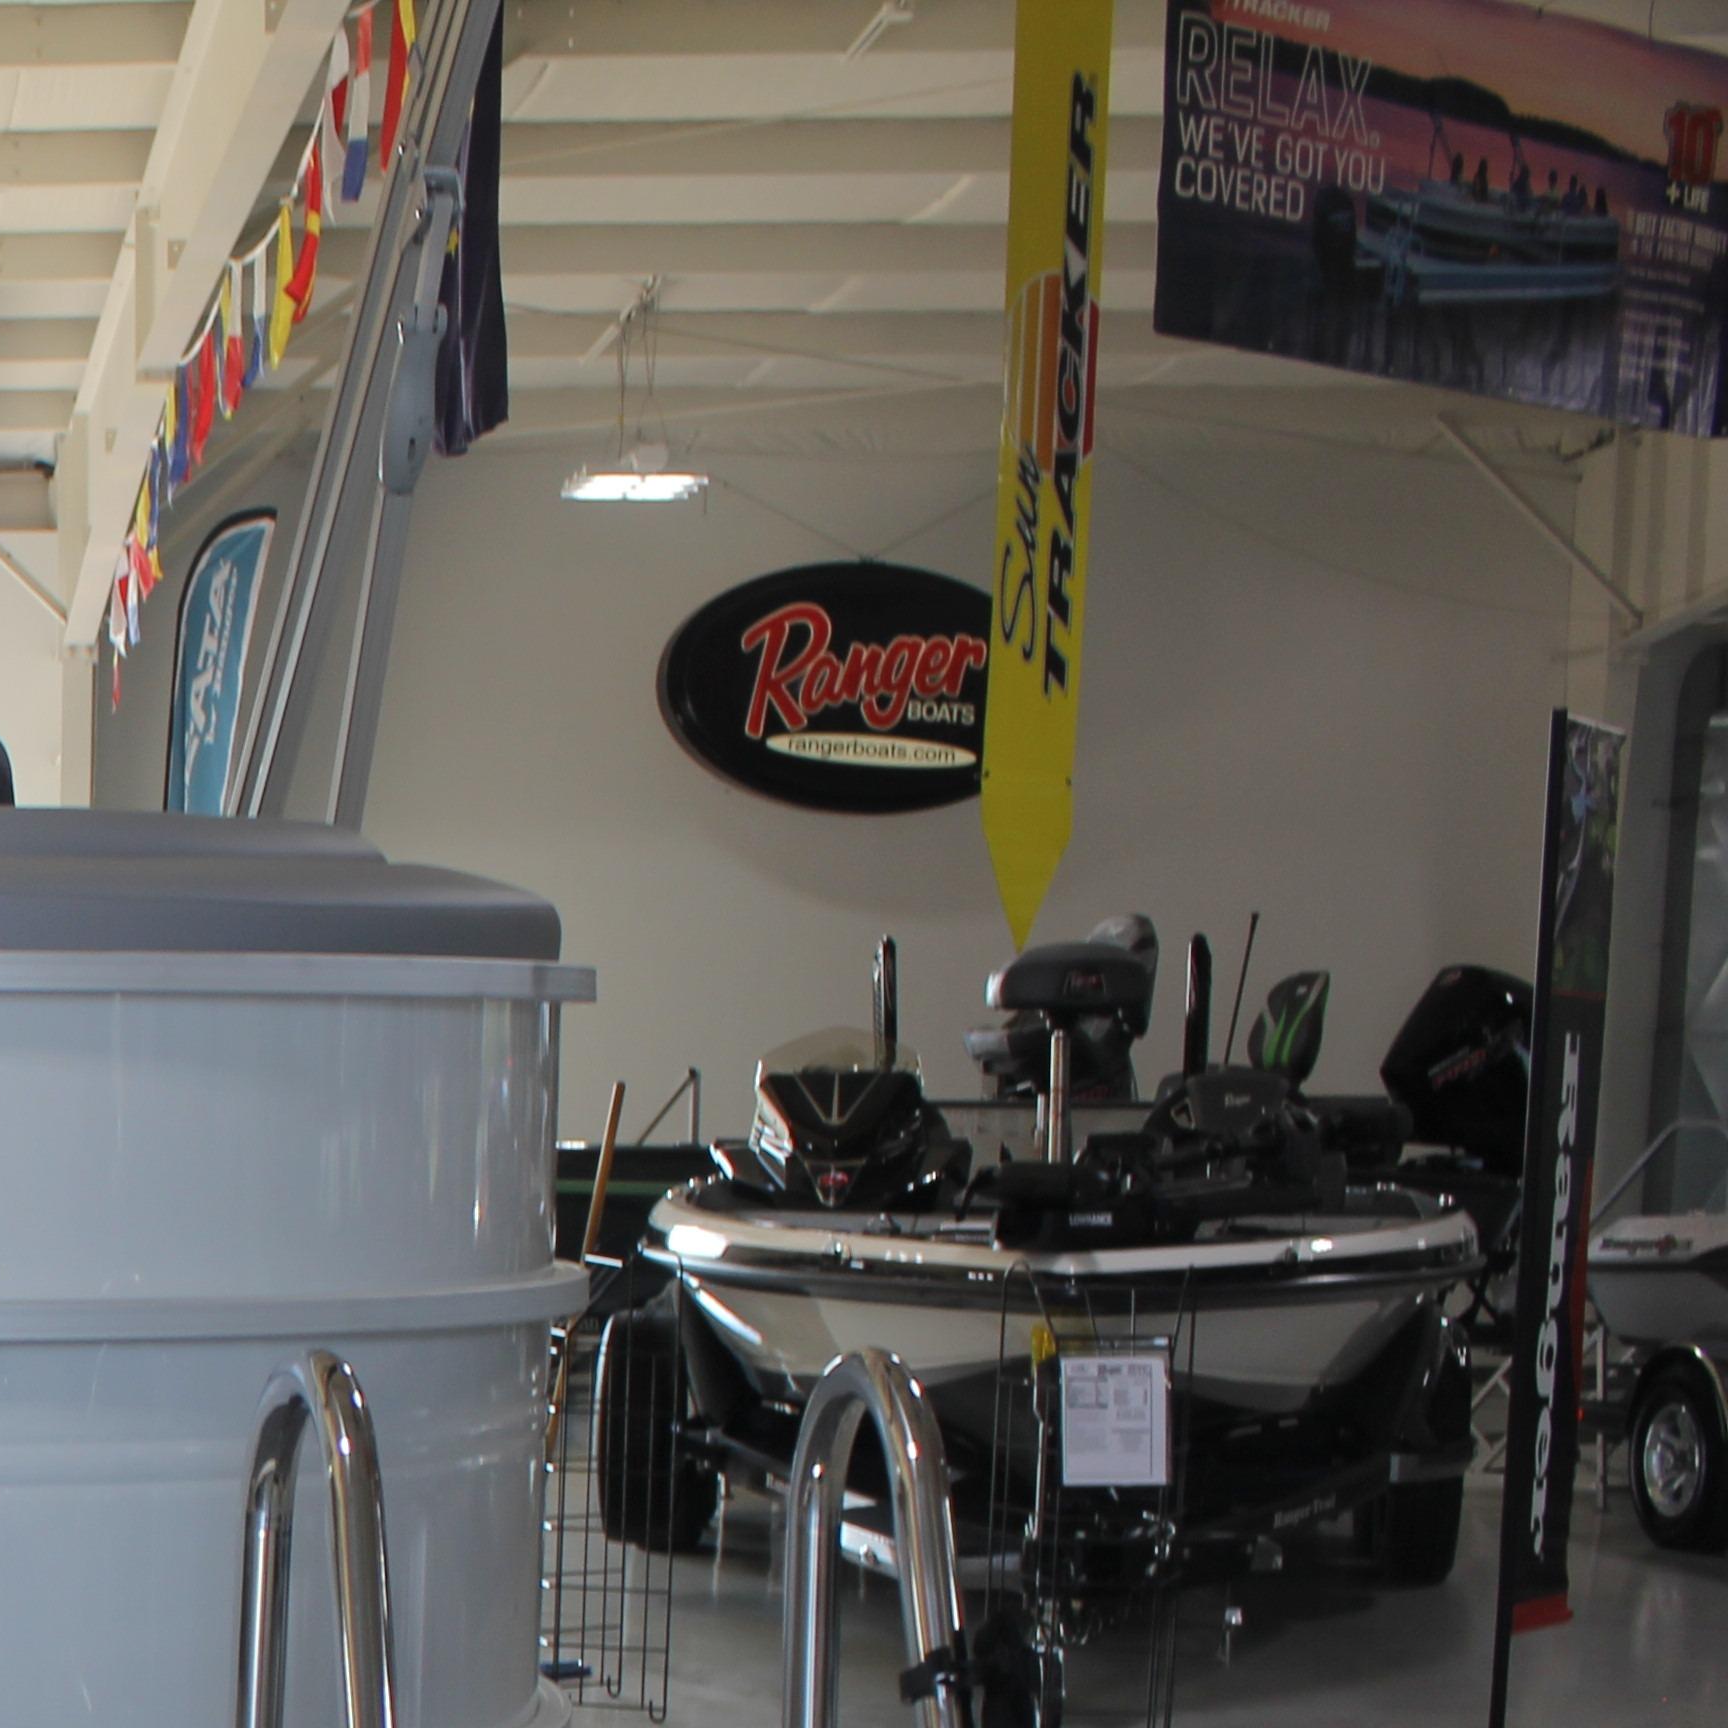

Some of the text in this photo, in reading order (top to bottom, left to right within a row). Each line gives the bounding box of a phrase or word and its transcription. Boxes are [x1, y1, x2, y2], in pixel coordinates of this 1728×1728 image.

[1174, 154, 1305, 223] COVERED
[1178, 109, 1385, 196] WE'VE GOT YOU
[1044, 69, 1097, 703] TRACKER
[741, 602, 988, 740] Ranger
[906, 699, 976, 727] BOATS
[787, 733, 957, 765] rangerboats.com
[1530, 1031, 1581, 1556] Ranger
